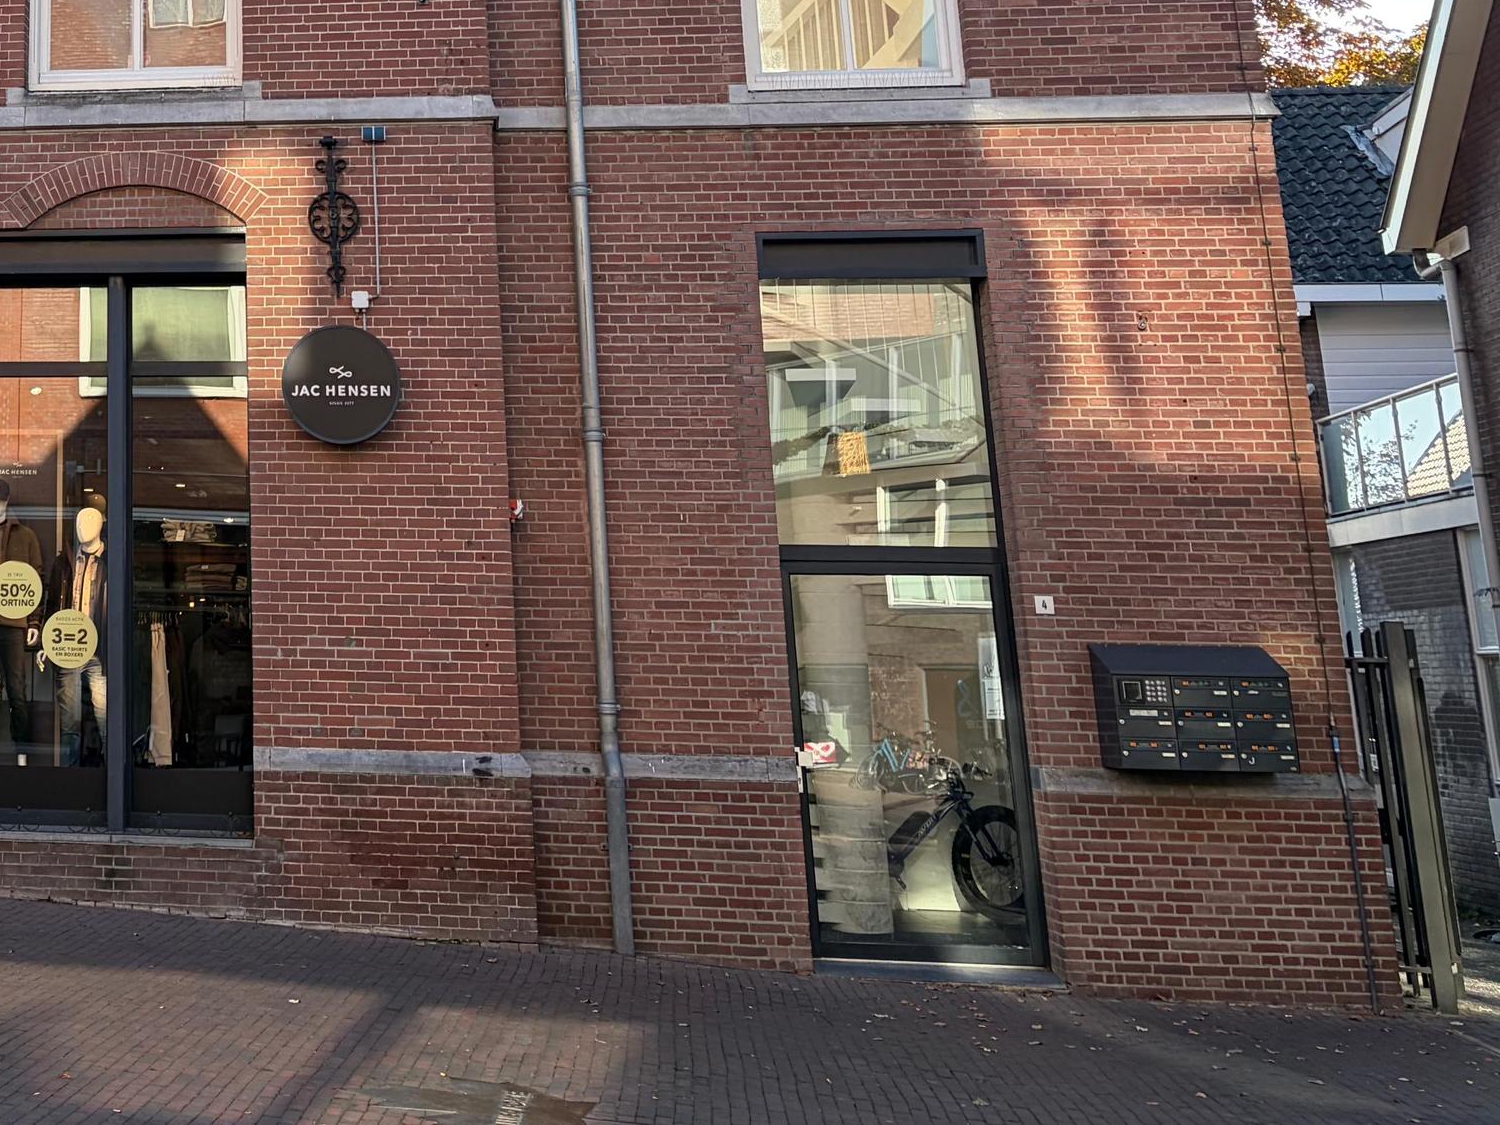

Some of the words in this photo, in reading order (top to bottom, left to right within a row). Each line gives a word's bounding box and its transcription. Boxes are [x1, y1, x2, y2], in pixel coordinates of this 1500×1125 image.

[291, 385, 320, 396] JAC
[325, 385, 391, 396] HENSEN
[1041, 599, 1048, 610] 4
[51, 628, 88, 644] 3=2
